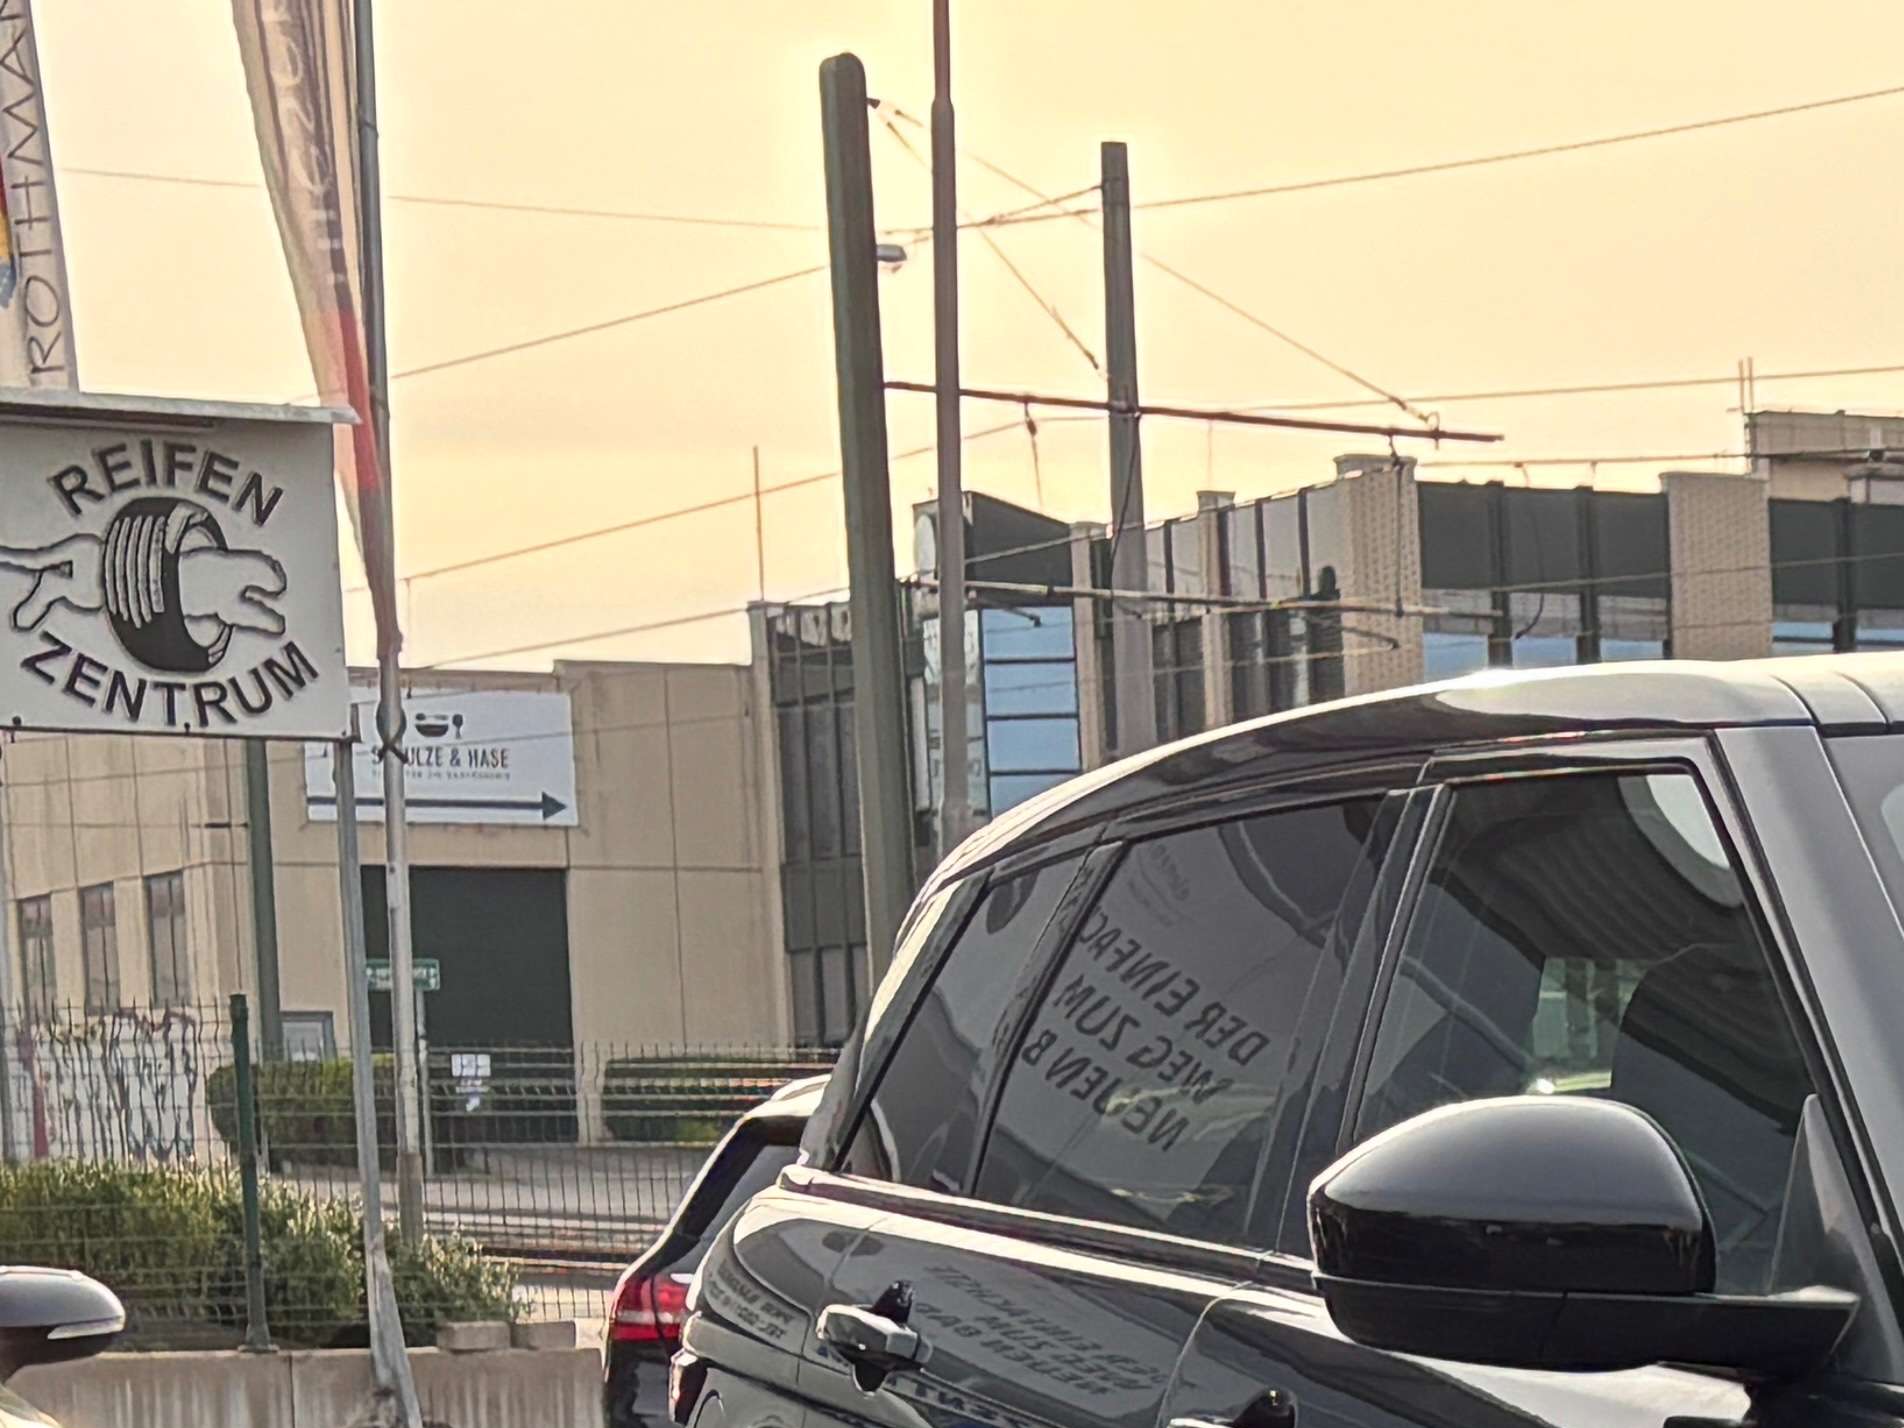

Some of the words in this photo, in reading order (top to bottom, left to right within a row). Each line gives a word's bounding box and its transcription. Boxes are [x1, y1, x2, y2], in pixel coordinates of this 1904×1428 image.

[48, 439, 284, 527] REIFEN
[20, 631, 320, 728] ZENTRUM
[371, 745, 443, 769] SULZE
[450, 746, 461, 768] &
[468, 746, 510, 769] HASE
